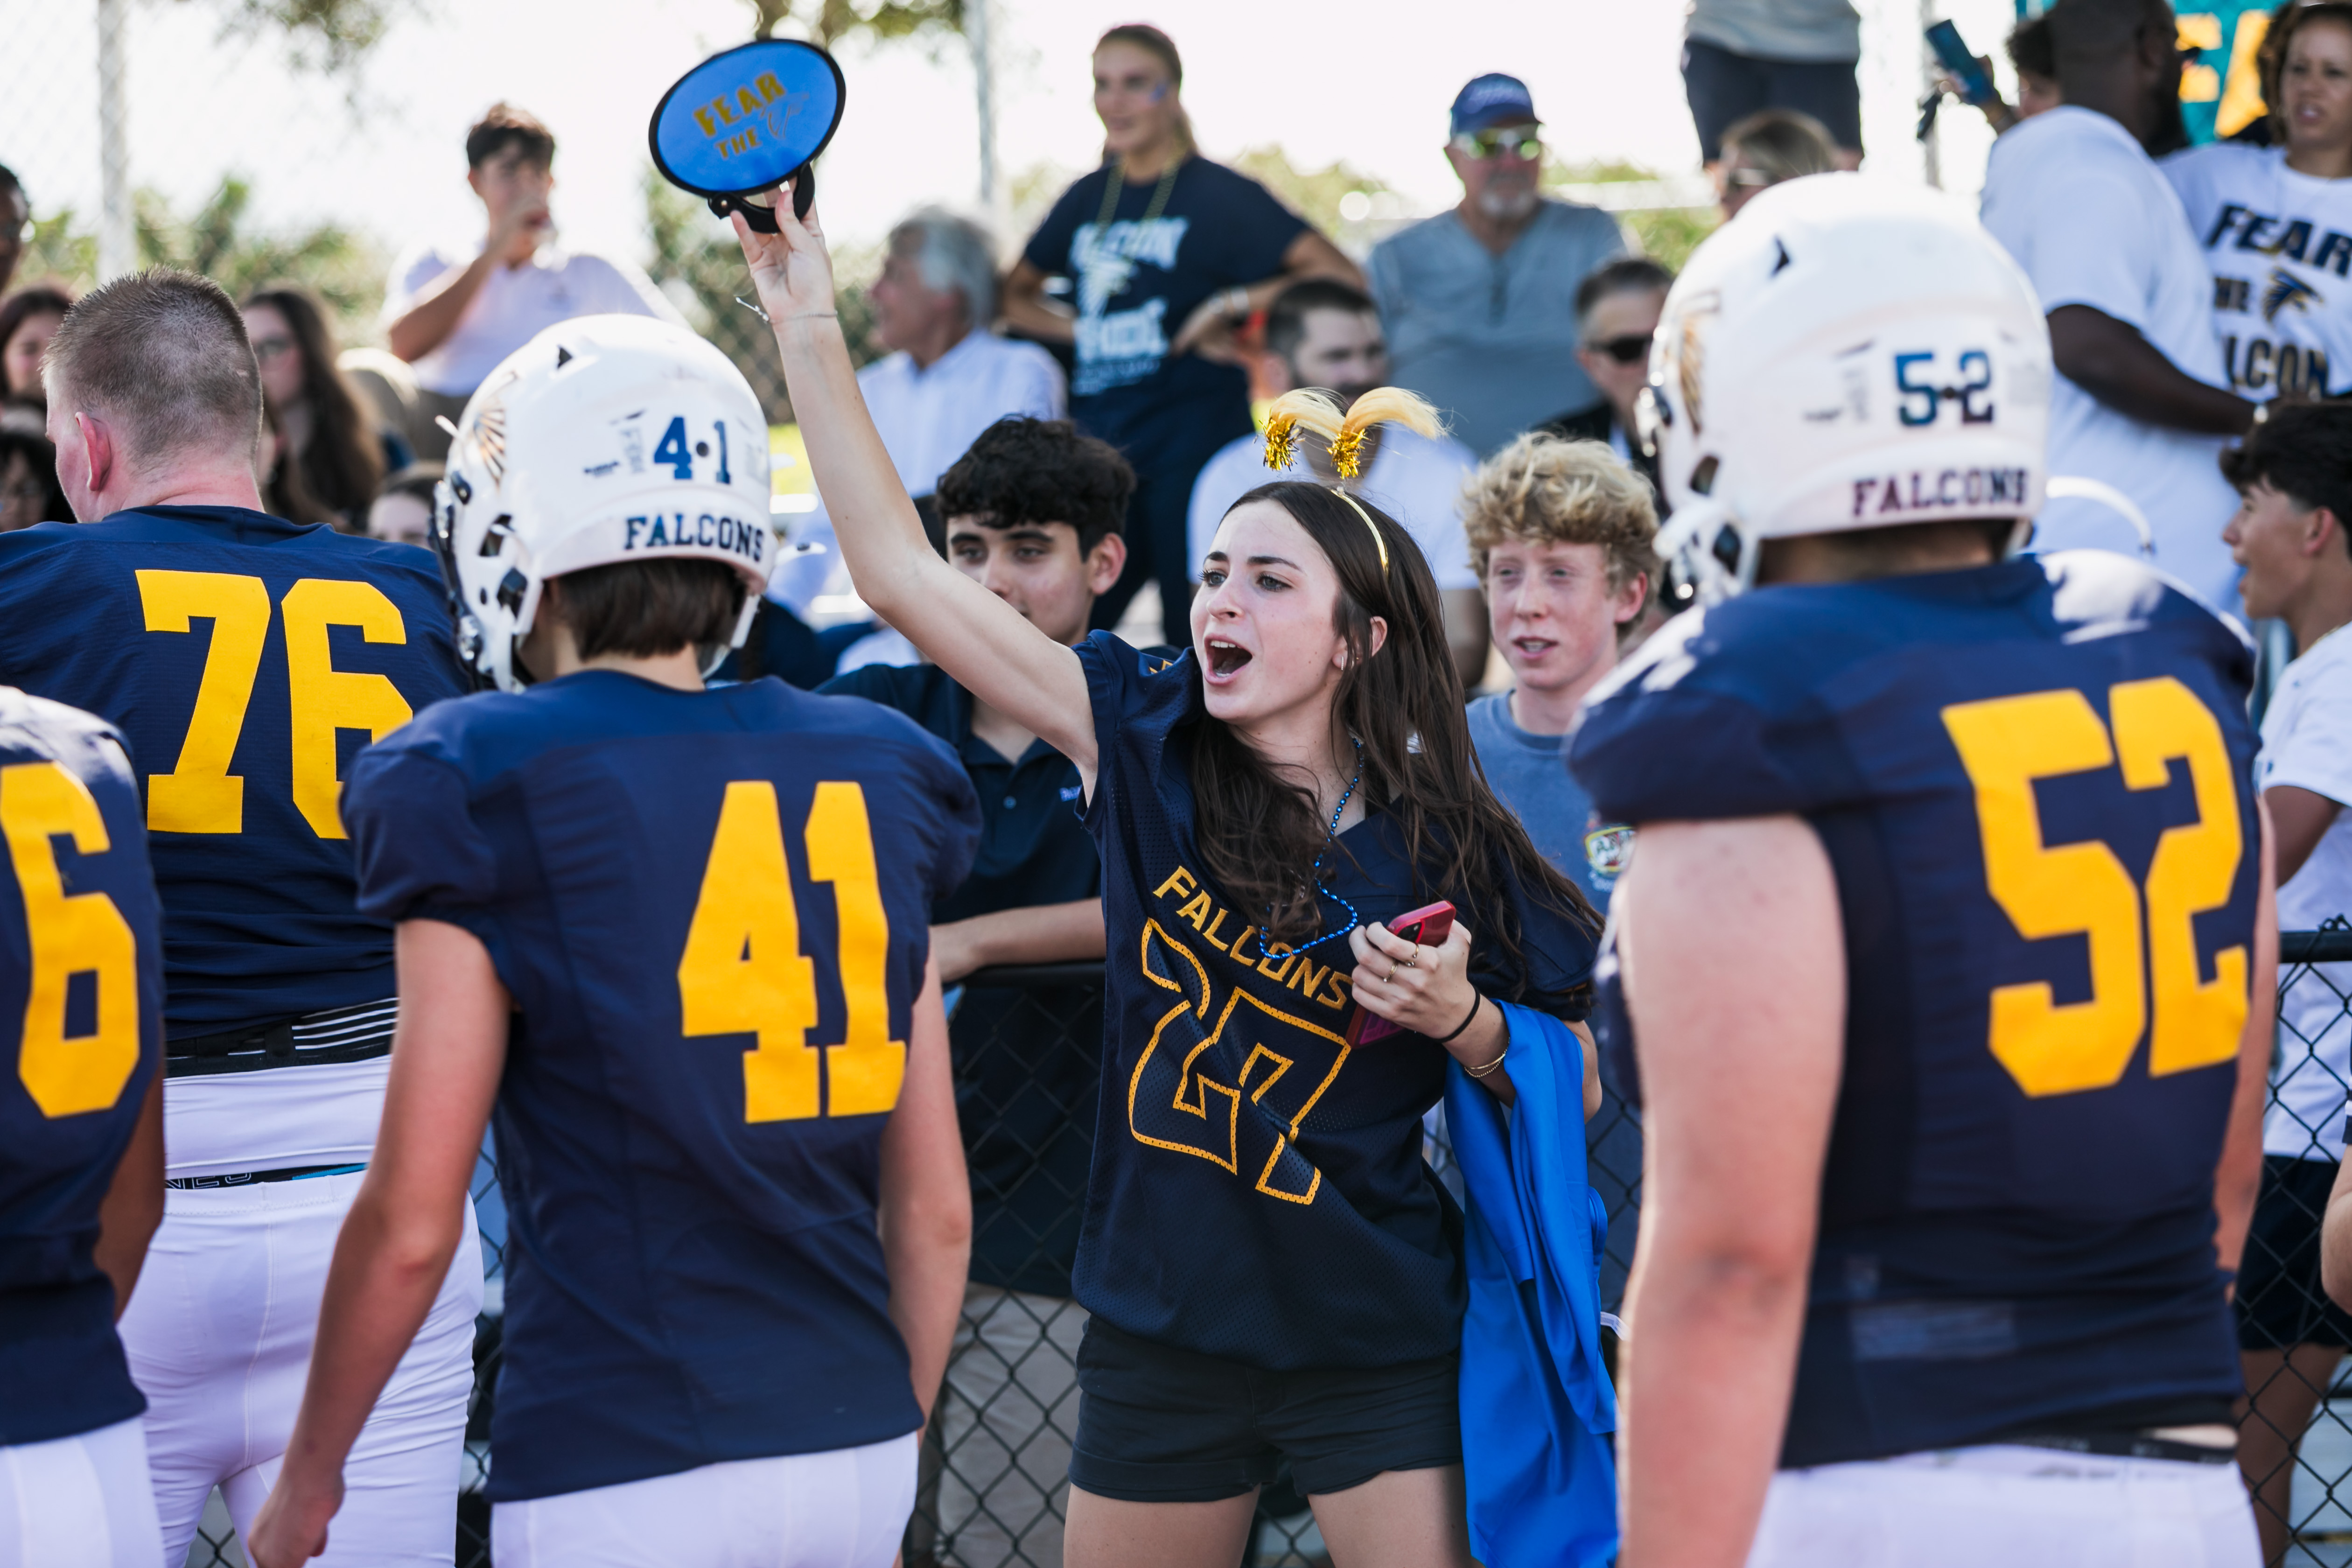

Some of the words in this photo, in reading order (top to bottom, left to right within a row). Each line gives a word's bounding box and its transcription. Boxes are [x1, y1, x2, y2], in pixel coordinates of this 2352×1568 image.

[693, 71, 786, 138] FEAR
[714, 126, 762, 160] THE
[2206, 204, 2352, 277] FEAR
[2224, 336, 2330, 399] LCON
[624, 512, 763, 562] FALCONS
[135, 569, 413, 839] 76
[0, 761, 139, 1119] 6
[1153, 865, 1354, 1011] FALCONS
[1940, 675, 2250, 1099] 52
[677, 780, 906, 1124] 41
